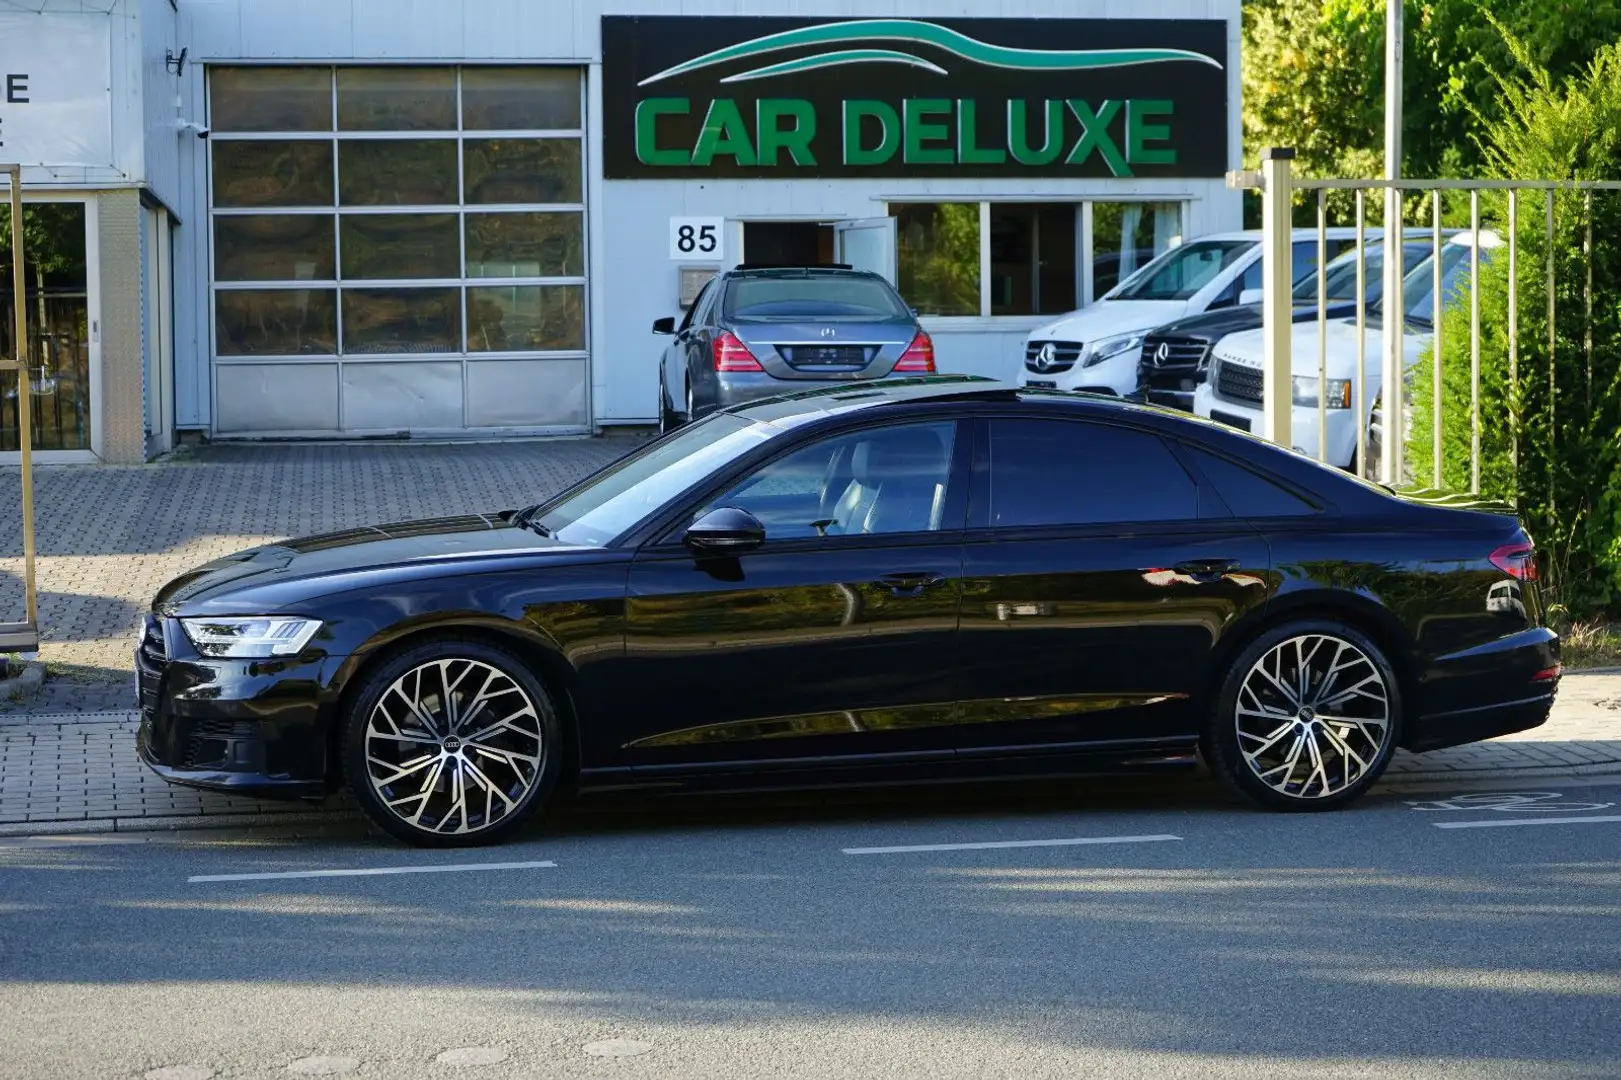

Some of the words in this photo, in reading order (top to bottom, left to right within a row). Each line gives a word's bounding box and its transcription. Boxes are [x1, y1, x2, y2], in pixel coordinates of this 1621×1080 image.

[0, 74, 29, 103] E
[635, 98, 817, 166] CAR
[842, 98, 1177, 177] DELUXE
[678, 224, 717, 252] 85
